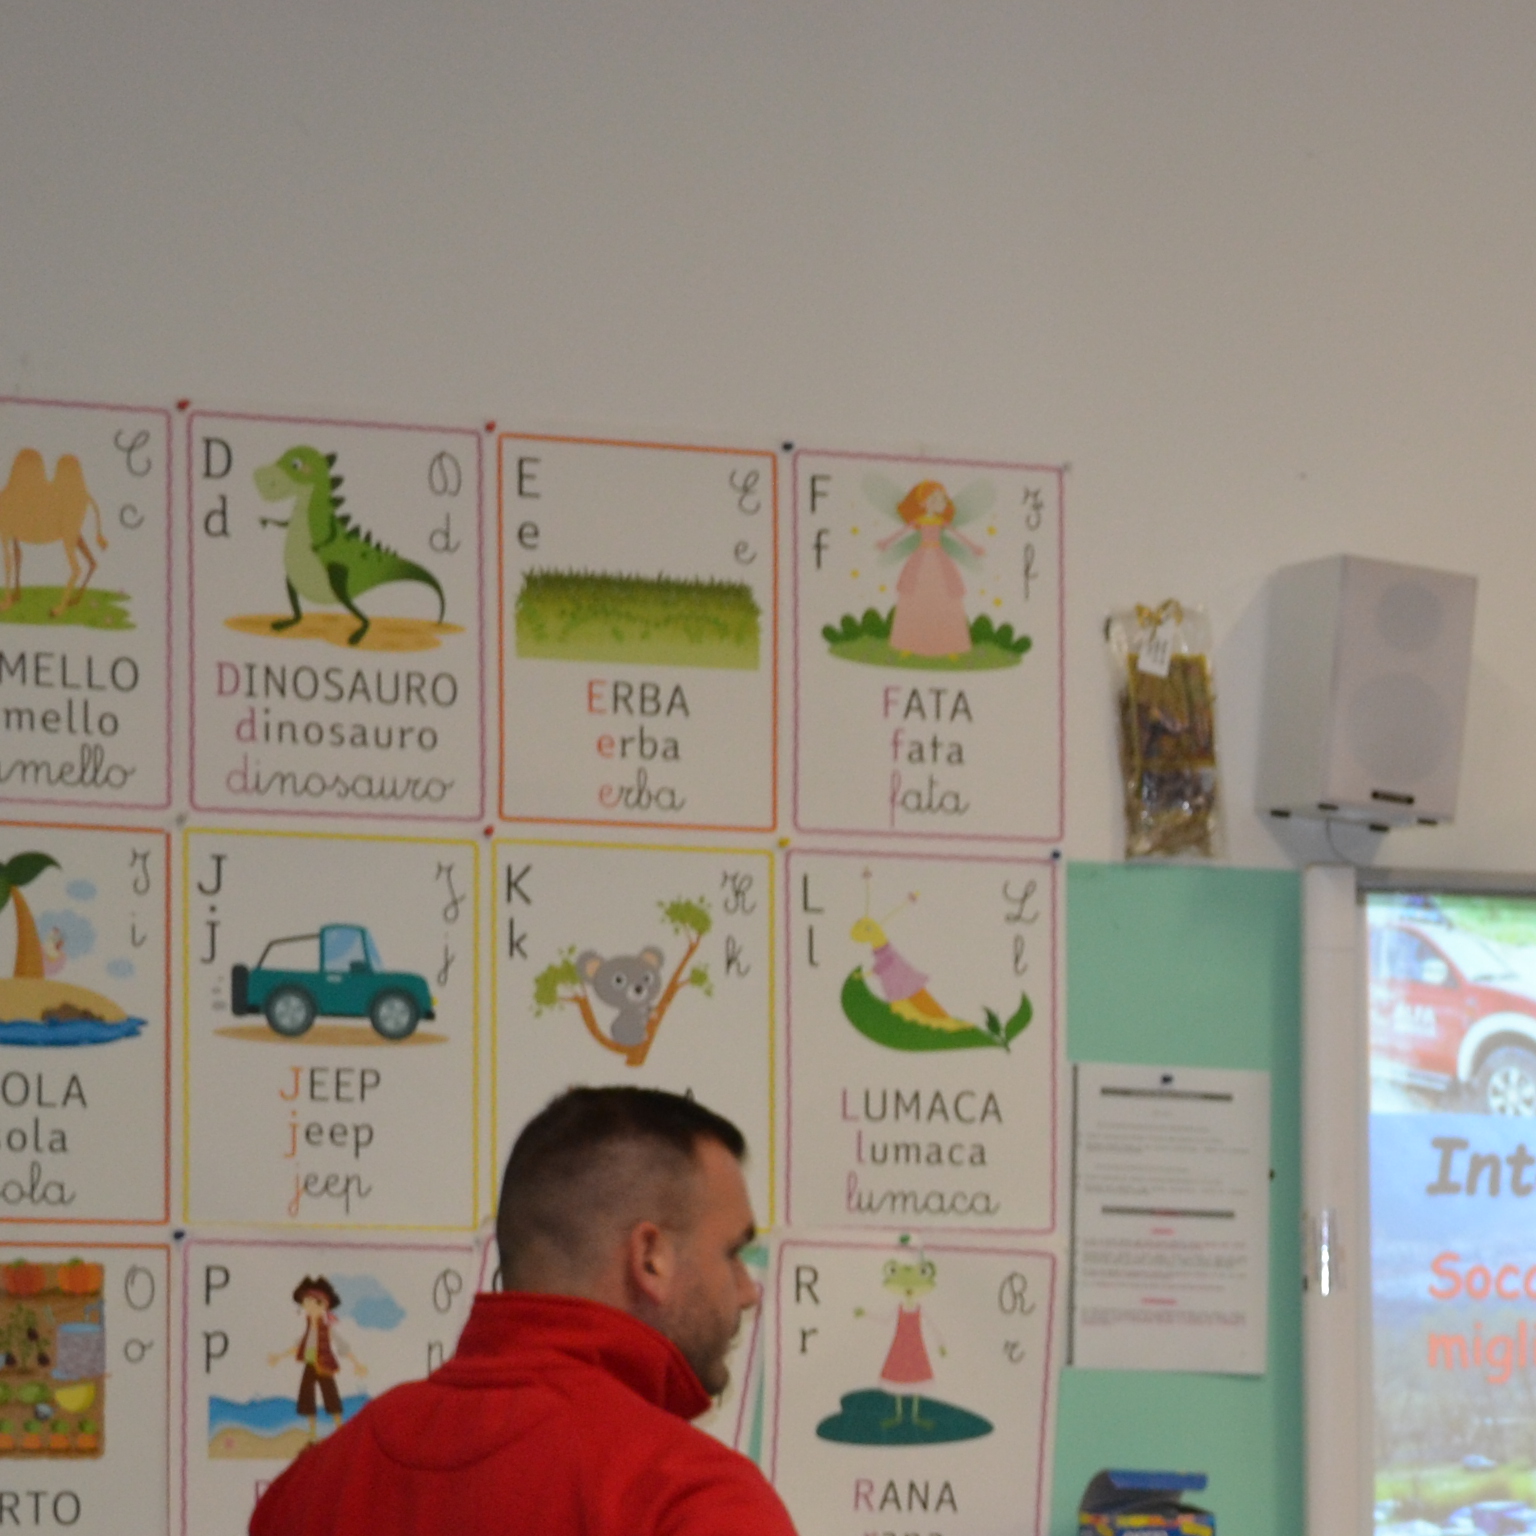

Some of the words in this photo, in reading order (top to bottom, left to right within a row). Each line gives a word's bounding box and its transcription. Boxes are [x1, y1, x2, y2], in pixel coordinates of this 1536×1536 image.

[115, 428, 151, 477] C
[202, 437, 233, 478] D
[428, 451, 462, 498] D
[517, 456, 541, 499] E
[810, 474, 831, 513] F
[119, 505, 145, 529] c
[204, 495, 229, 538] d
[430, 513, 461, 553] d
[517, 519, 540, 549] e
[734, 541, 757, 565] e
[813, 528, 830, 570] f
[216, 662, 458, 707] DINOSAURO
[588, 678, 689, 718] ERBA
[883, 685, 974, 723] FATA
[235, 708, 438, 751] dinosauro
[597, 725, 680, 762] erba
[891, 728, 964, 766] fata
[226, 753, 454, 801] dinosauro
[598, 766, 687, 813] erba
[888, 772, 970, 828] fata
[198, 853, 228, 897] J
[505, 864, 532, 905] K
[801, 872, 824, 913] L
[200, 905, 220, 965] j
[508, 917, 529, 960] k
[436, 931, 456, 986] j
[0, 1071, 88, 1110] OLA
[279, 1066, 381, 1102] JEEP
[840, 1088, 1002, 1124] LUMACA
[7, 1116, 68, 1154] ola
[283, 1110, 374, 1159] jeep
[855, 1130, 987, 1167] lumaca
[286, 1160, 373, 1217] jeep
[845, 1171, 1000, 1217] lumaca
[125, 1265, 155, 1310] O
[206, 1265, 230, 1305] P
[433, 1268, 463, 1314] P
[796, 1266, 819, 1304] R
[999, 1273, 1035, 1315] R
[205, 1329, 229, 1374] p
[800, 1324, 817, 1352] r
[854, 1478, 958, 1513] RANA
